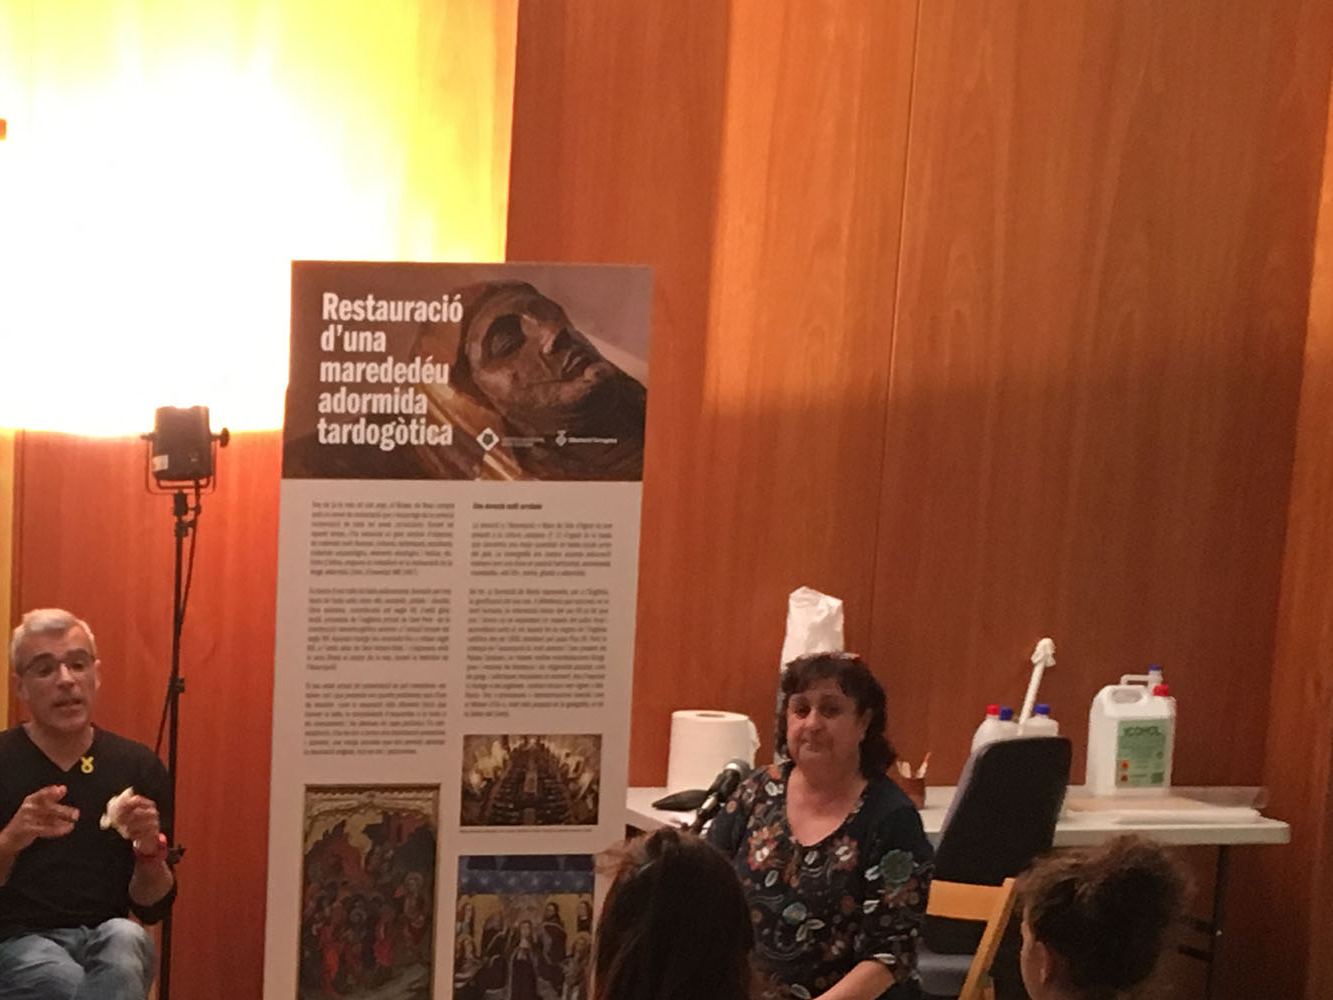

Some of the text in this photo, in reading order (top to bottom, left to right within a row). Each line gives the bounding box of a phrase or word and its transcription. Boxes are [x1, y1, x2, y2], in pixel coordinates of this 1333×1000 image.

[322, 292, 464, 324] Restauració
[320, 324, 387, 353] d'una
[319, 355, 450, 385] marededéu
[318, 387, 428, 415] adormida
[317, 416, 454, 452] tardogòtica
